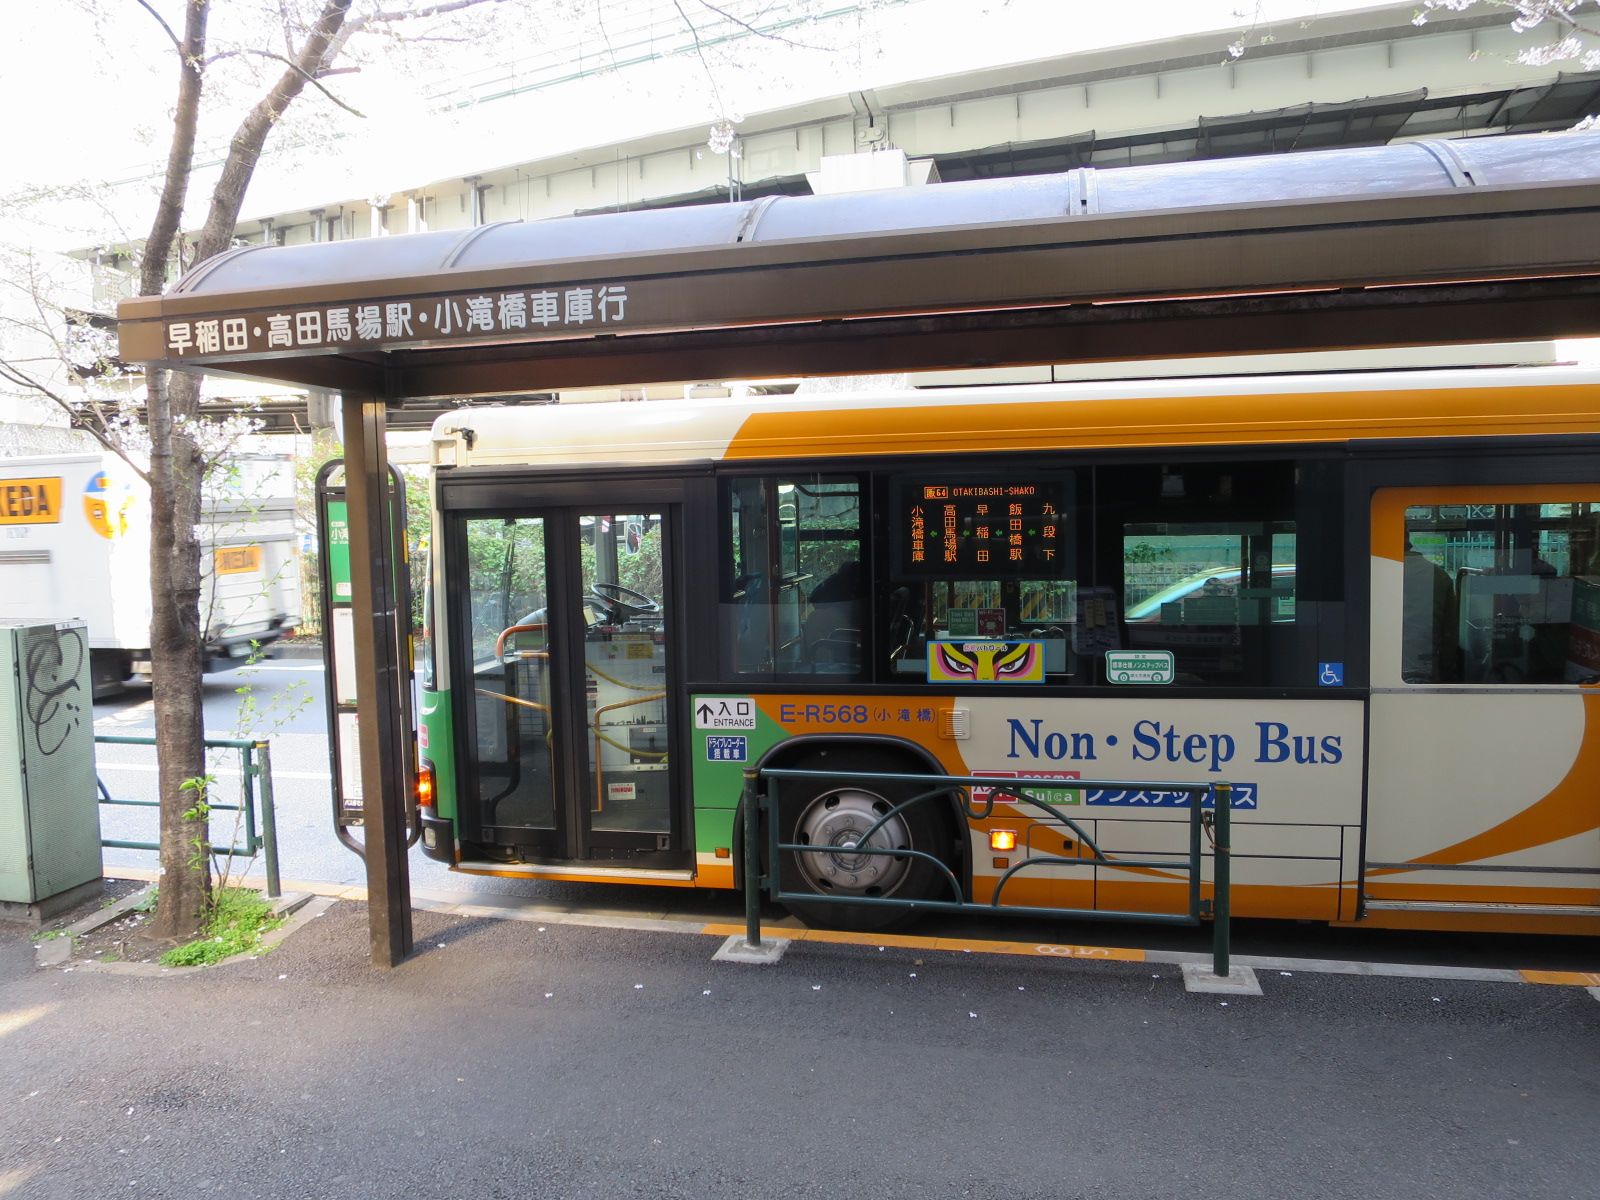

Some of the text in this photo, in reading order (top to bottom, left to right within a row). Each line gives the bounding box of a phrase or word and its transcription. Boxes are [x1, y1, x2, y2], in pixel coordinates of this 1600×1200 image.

[0, 485, 51, 516] EDA
[953, 486, 1035, 496] OTAKIBASHI-SHAKO
[911, 505, 925, 562] 小滝橋車庫
[943, 504, 957, 562] 高田馬場駅
[976, 504, 989, 562] 早稲田
[1009, 503, 1022, 561] 飯田橋駅
[1042, 502, 1056, 560] 九段下
[714, 718, 755, 727] ENTRANCE
[718, 701, 750, 716] 入口
[780, 703, 869, 724] E-R568
[1006, 718, 1343, 772] Non Step Bus
[1024, 789, 1073, 802] Suica
